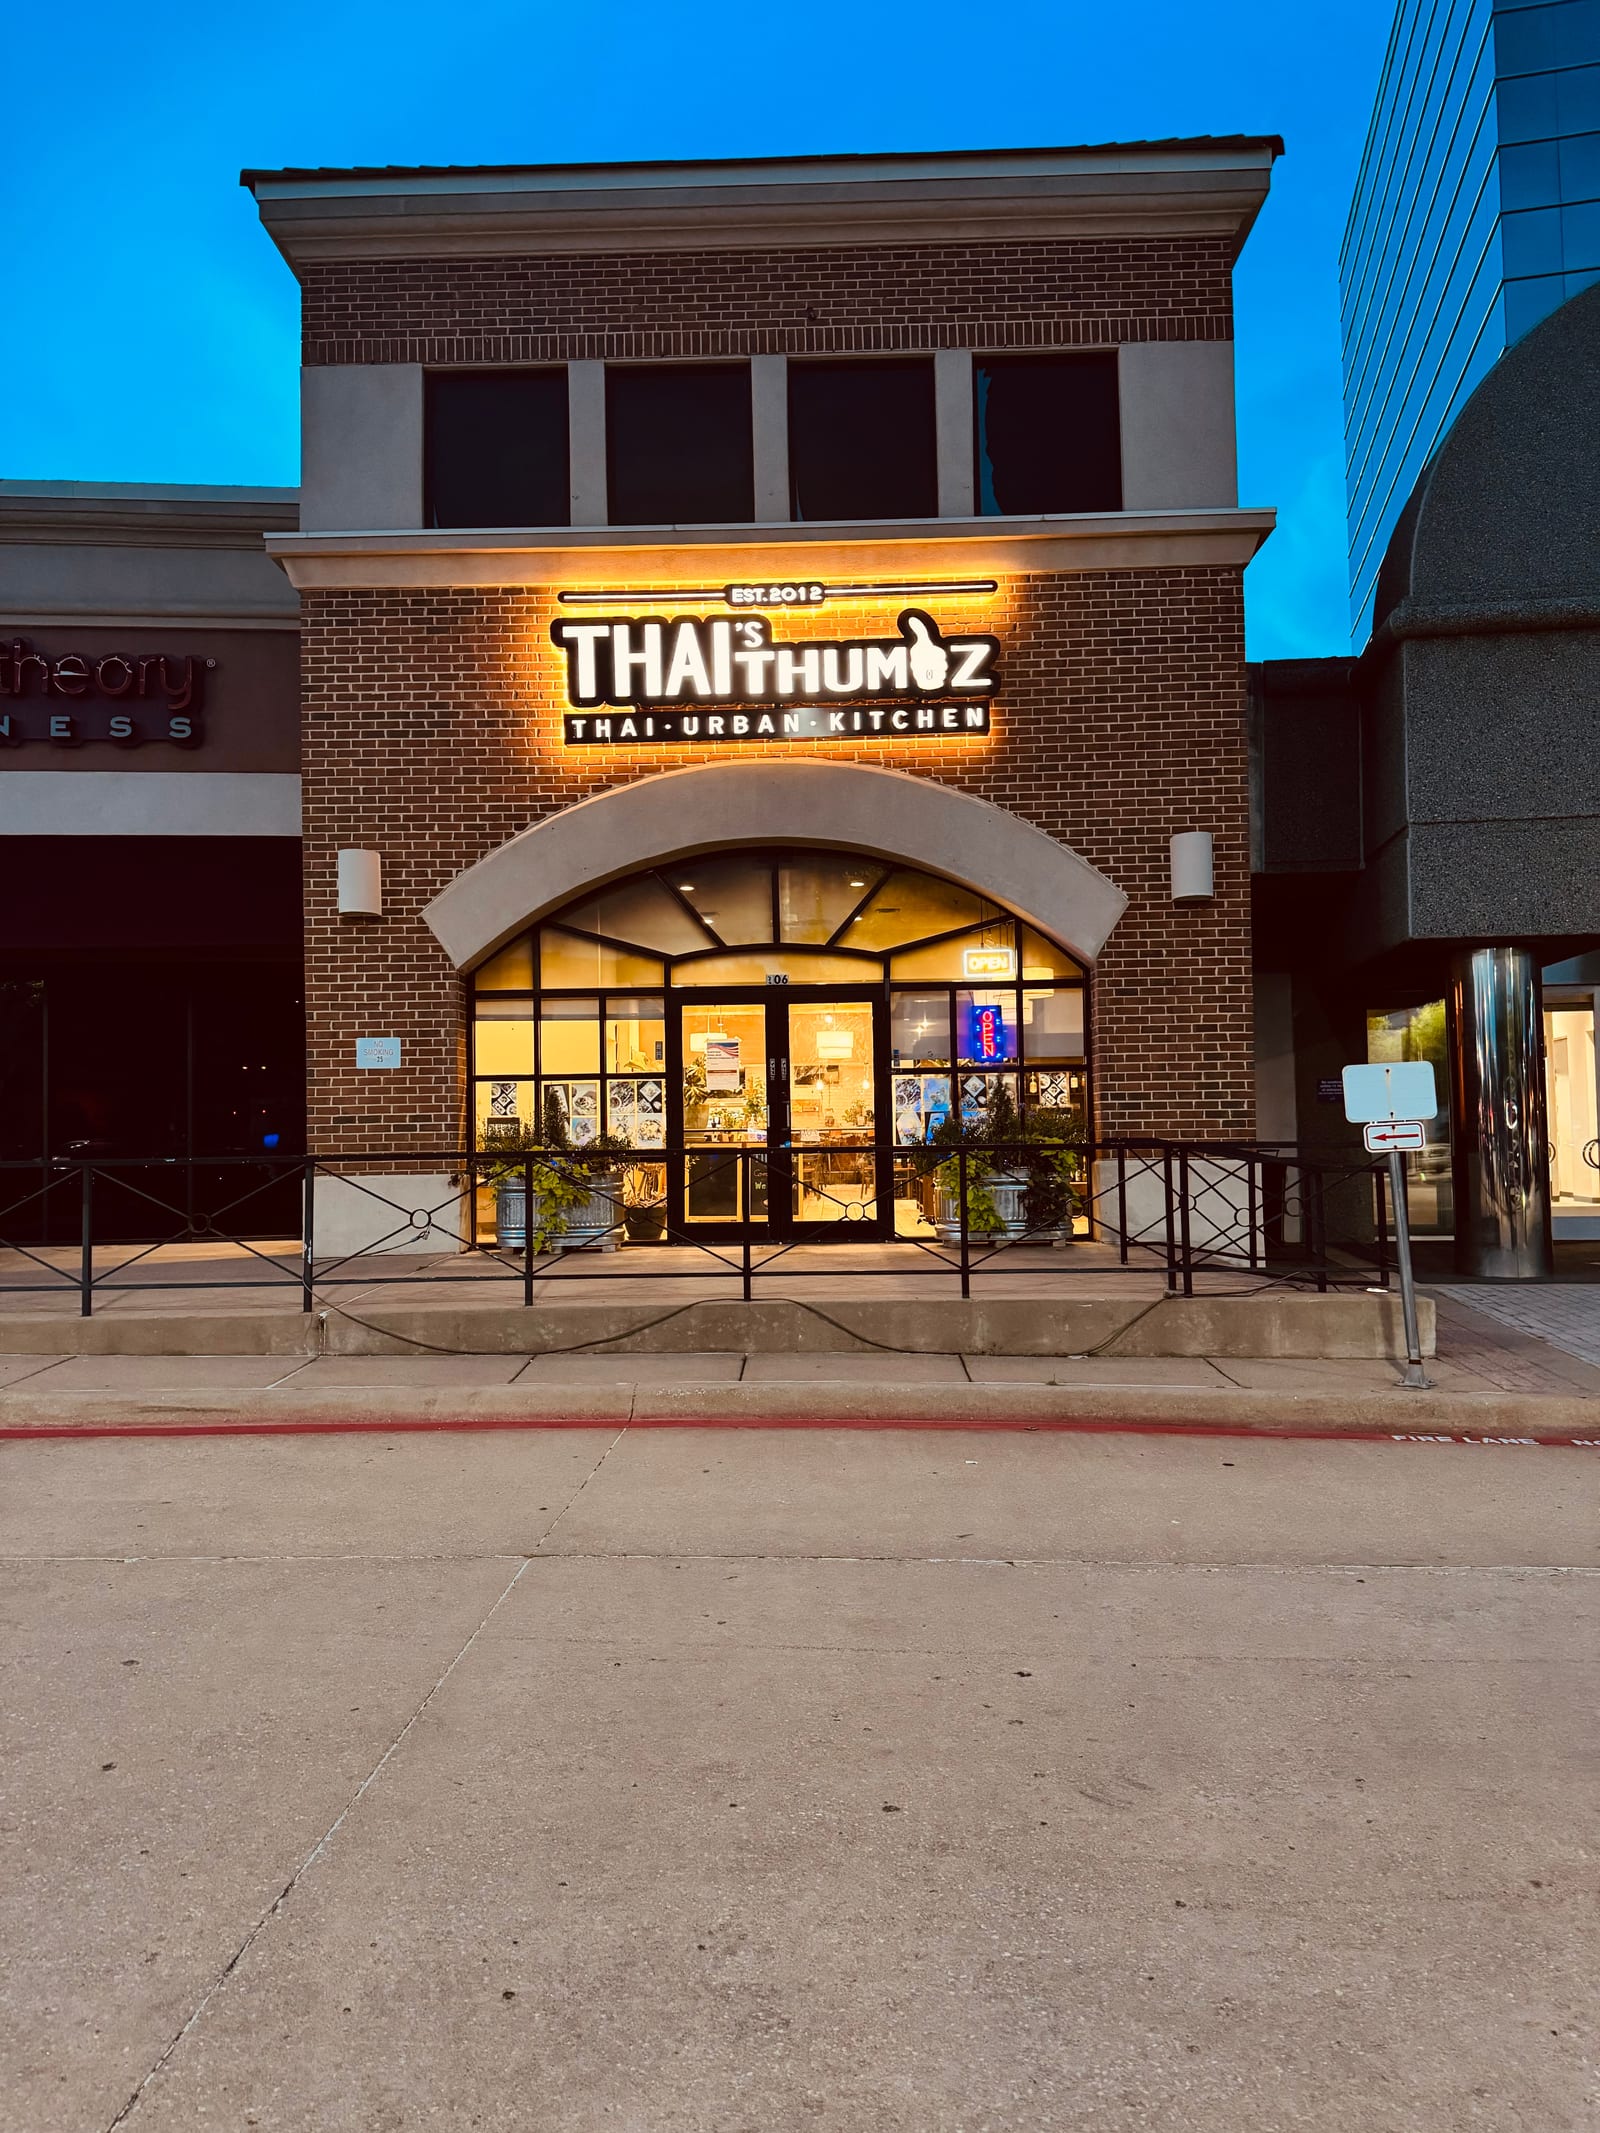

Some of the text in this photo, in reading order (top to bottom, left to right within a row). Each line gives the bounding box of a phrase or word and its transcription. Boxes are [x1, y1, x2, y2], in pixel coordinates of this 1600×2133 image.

[572, 707, 984, 738] THAI URBAN KITCHEN
[968, 957, 1008, 970] OPEN
[982, 1010, 994, 1057] OPEN
[1391, 1434, 1456, 1443] FIRE
[1462, 1436, 1540, 1445] LANE
